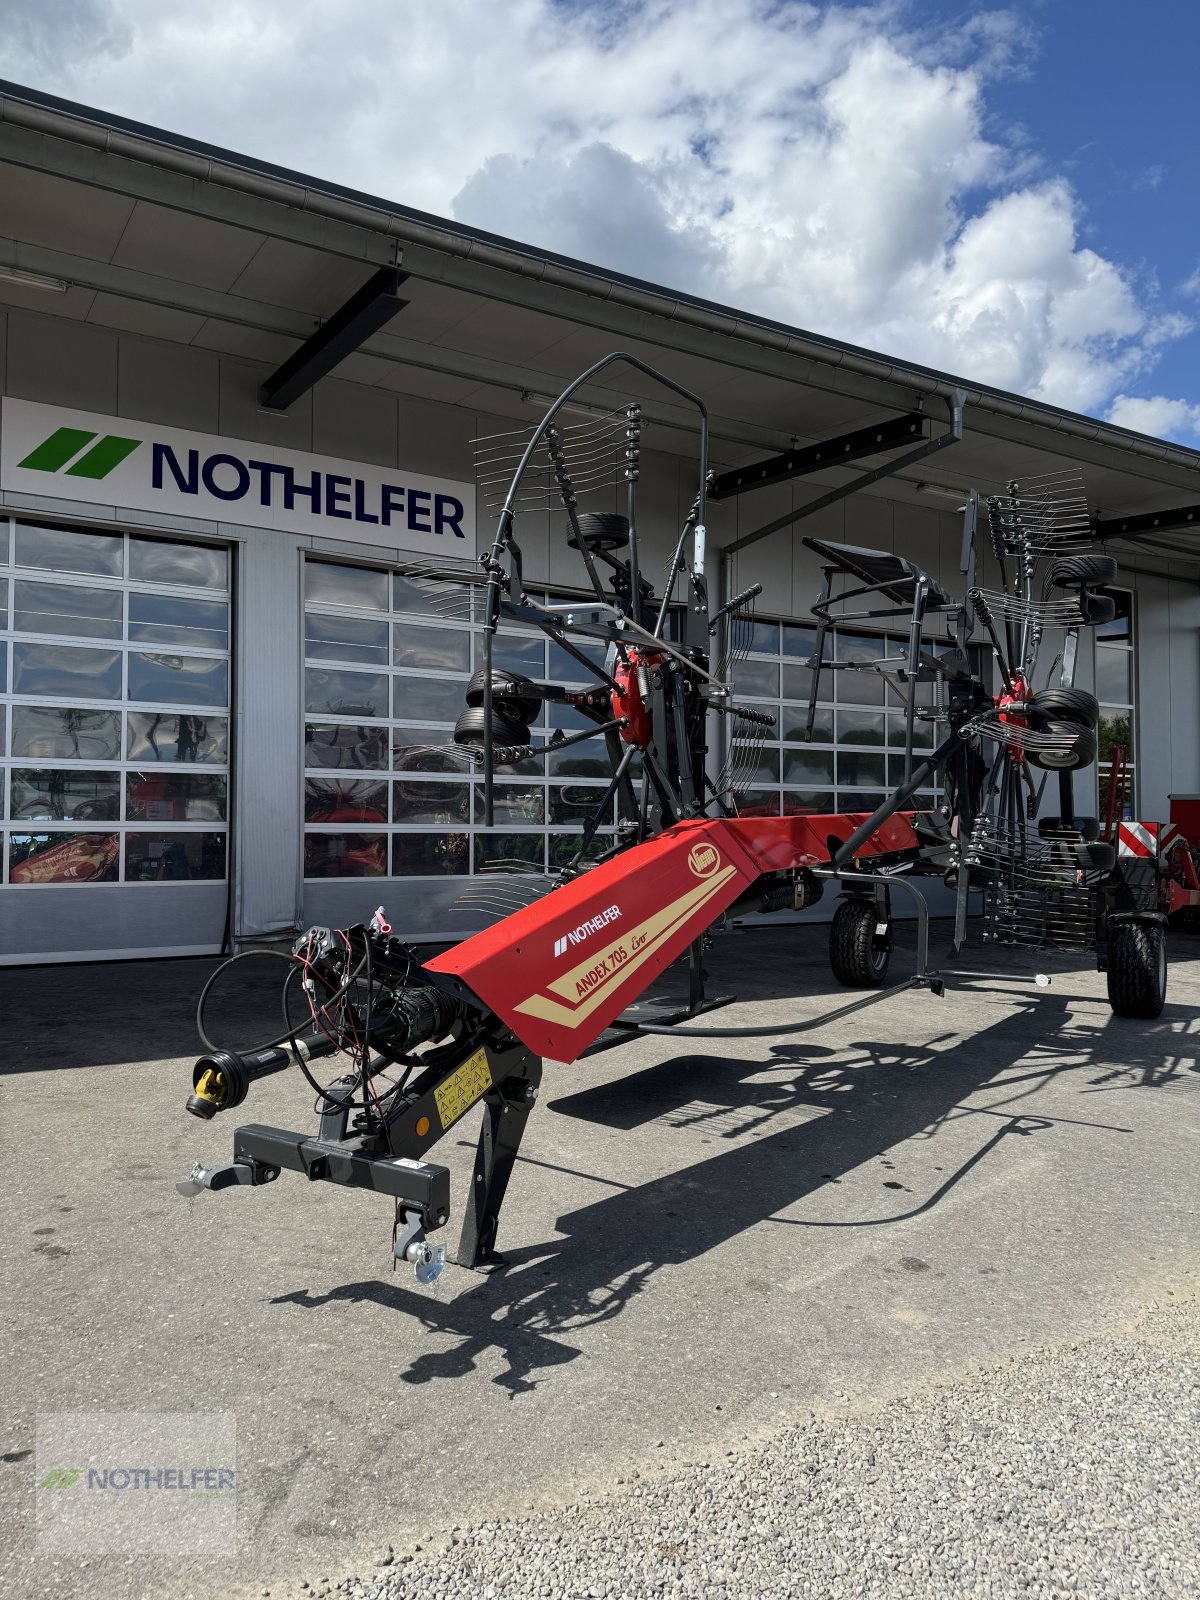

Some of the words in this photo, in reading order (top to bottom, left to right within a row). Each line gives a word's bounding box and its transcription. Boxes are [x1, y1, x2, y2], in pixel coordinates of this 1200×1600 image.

[152, 442, 466, 539] NOTHELFER
[688, 845, 717, 874] Vicon
[569, 905, 622, 945] NOTHELFER
[575, 962, 610, 996] ANDEX
[609, 946, 627, 969] 705
[632, 932, 648, 950] Evo
